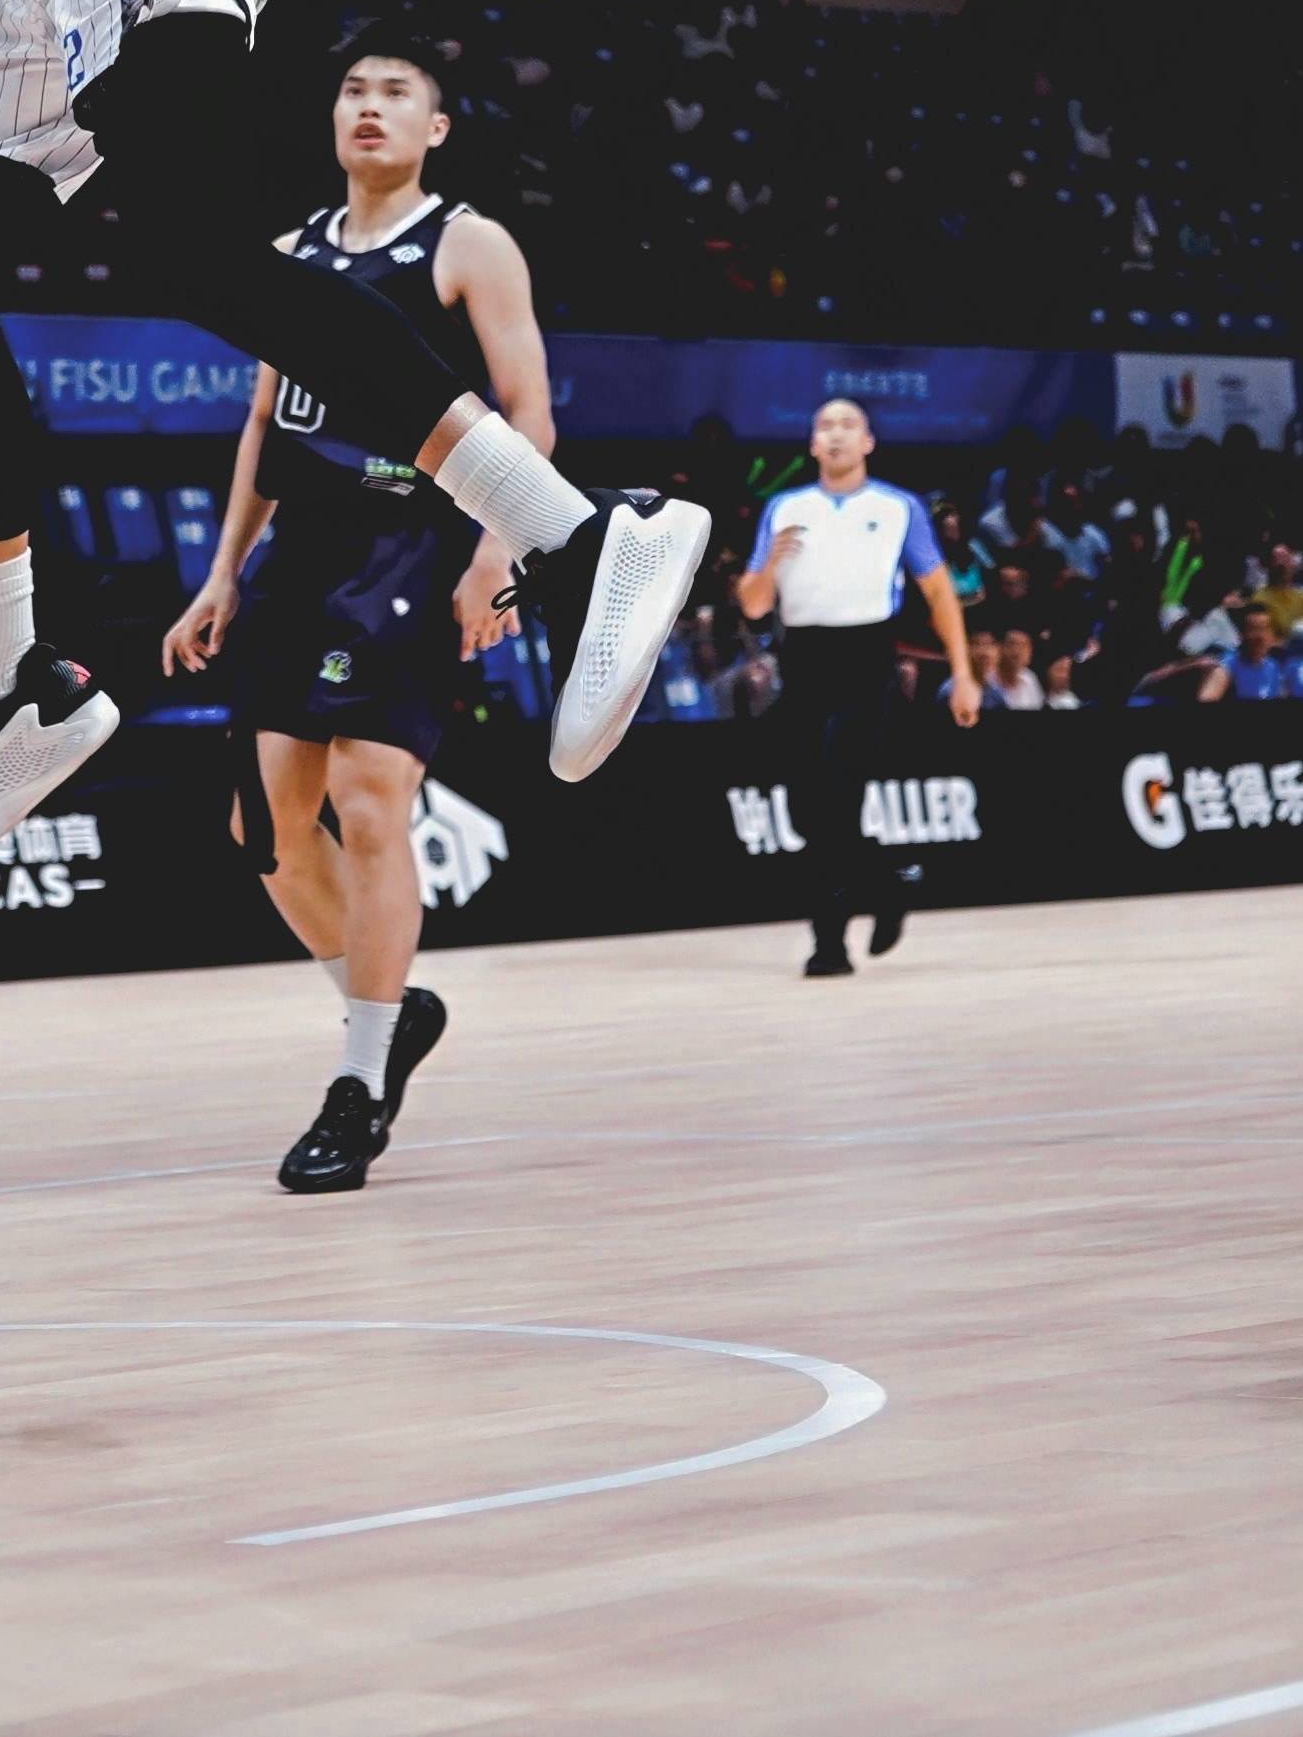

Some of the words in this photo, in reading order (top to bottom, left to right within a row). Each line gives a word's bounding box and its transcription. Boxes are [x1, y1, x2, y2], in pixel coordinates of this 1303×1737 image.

[63, 28, 86, 92] 2
[50, 359, 138, 403] FISU
[1122, 751, 1187, 850] G
[410, 777, 510, 910] AT
